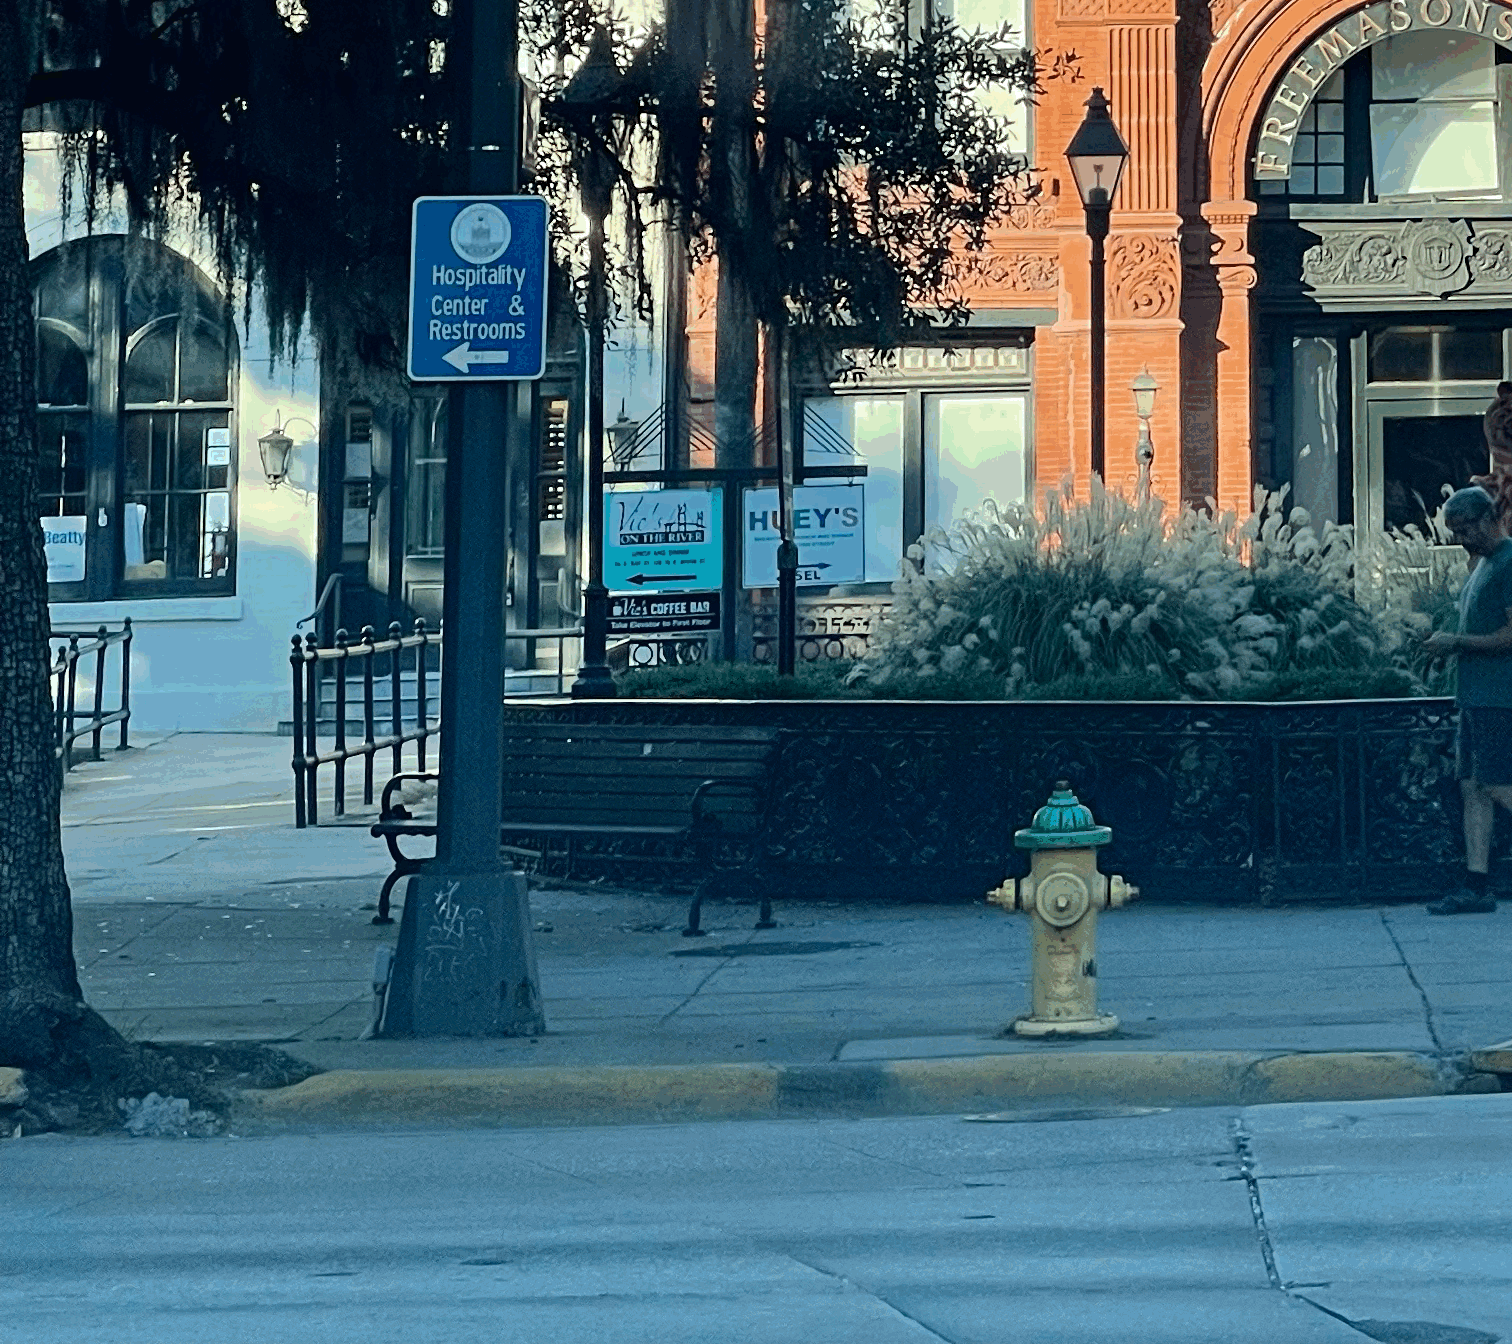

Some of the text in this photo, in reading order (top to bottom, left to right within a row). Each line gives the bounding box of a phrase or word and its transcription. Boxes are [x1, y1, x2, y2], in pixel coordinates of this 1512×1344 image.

[432, 264, 526, 292] Hospitality
[431, 294, 525, 316] Center &
[429, 319, 526, 340] Restrooms
[616, 496, 663, 531] Vic's
[620, 532, 703, 544] ON THE RIVER
[620, 598, 710, 616] Vic's COFFEE BAR
